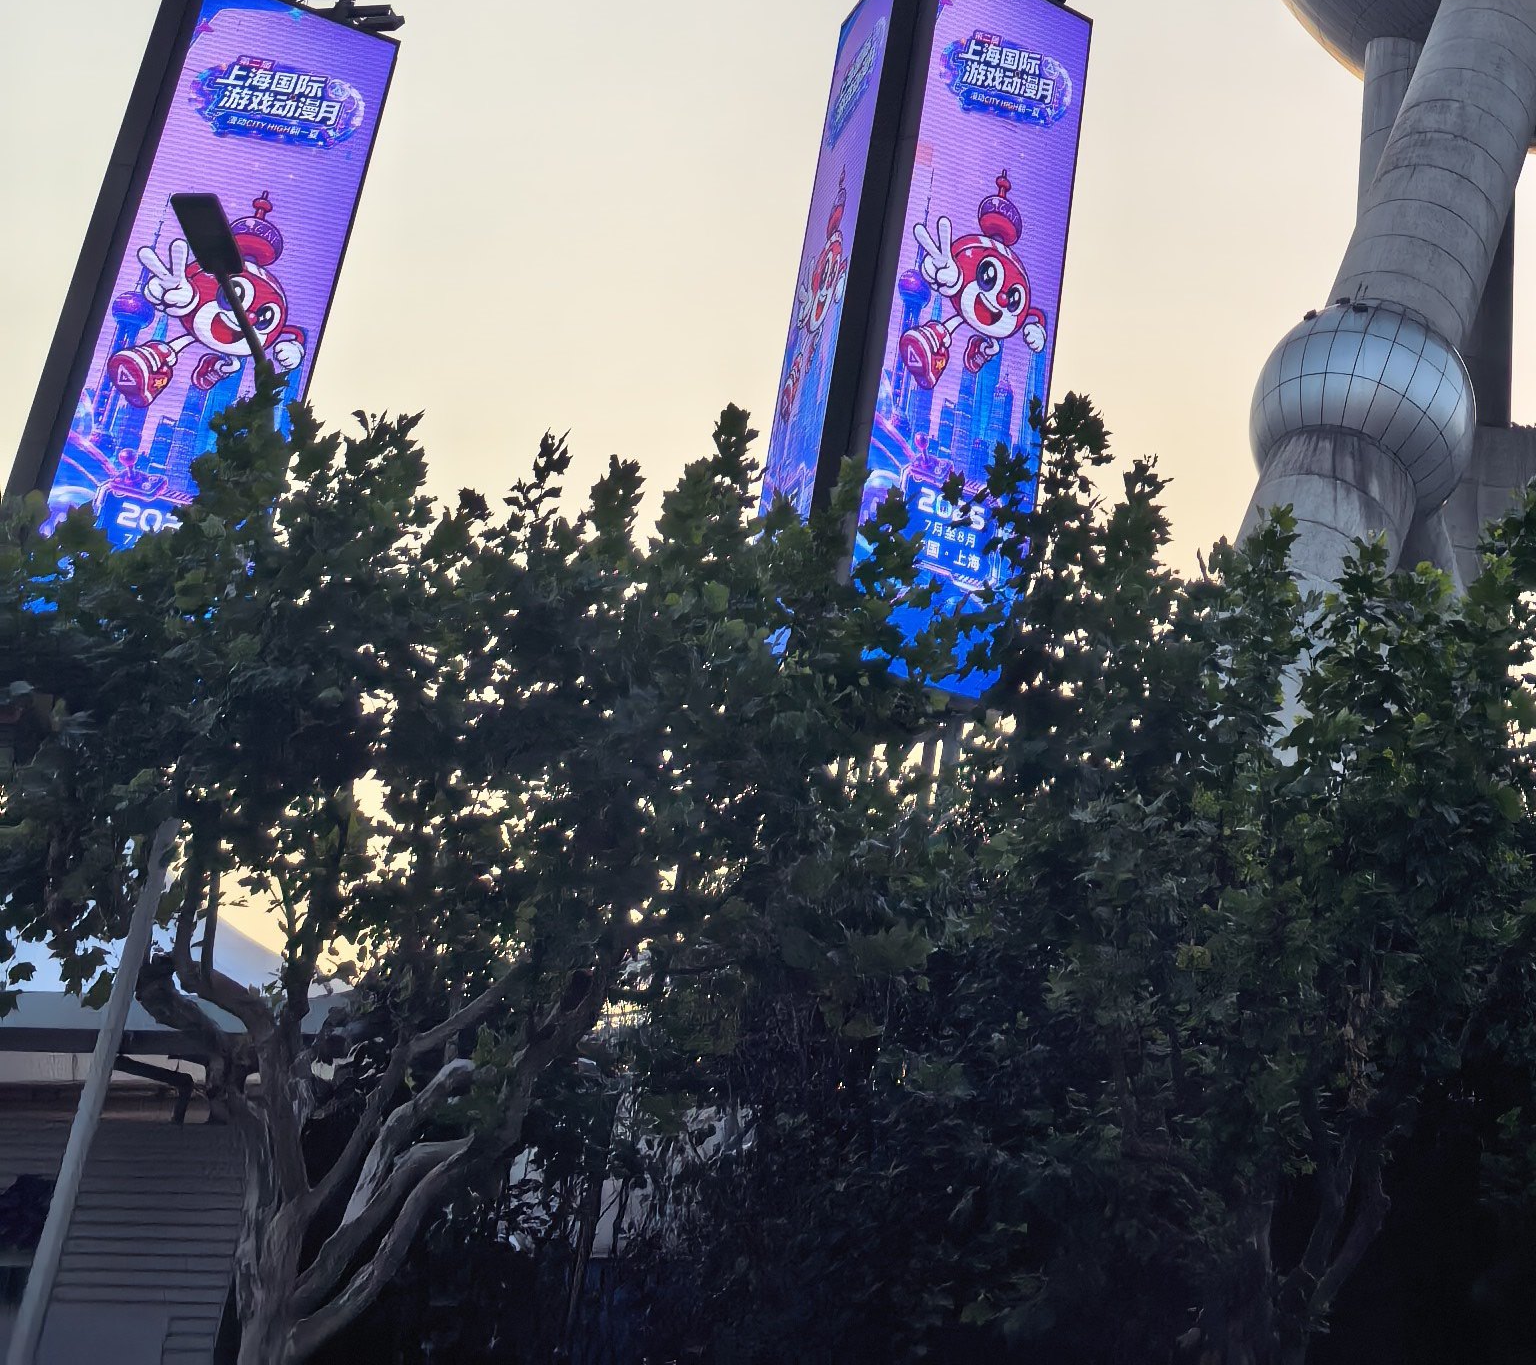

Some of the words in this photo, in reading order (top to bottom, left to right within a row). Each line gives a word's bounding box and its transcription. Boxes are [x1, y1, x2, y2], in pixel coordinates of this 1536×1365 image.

[959, 39, 1041, 75] 上海国际
[216, 65, 325, 97] 上海国际
[962, 61, 1055, 103] 游戏动漫月
[218, 86, 342, 125] 游戏动漫月
[924, 519, 976, 548] 7月至8月
